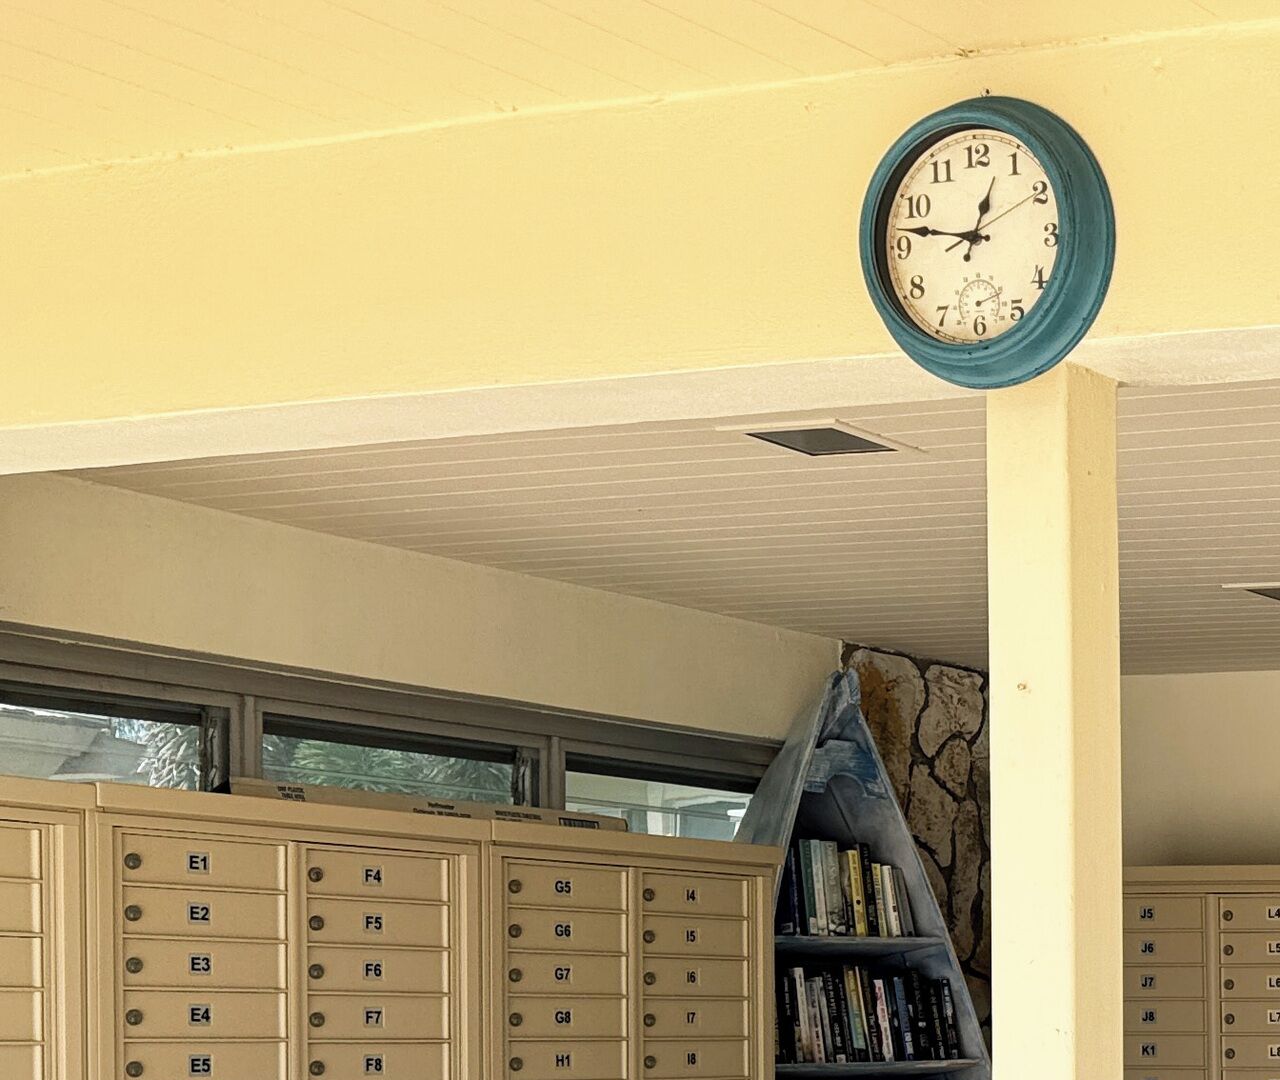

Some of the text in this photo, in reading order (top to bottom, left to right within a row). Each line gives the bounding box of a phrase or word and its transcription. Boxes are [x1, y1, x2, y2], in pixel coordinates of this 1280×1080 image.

[964, 144, 990, 169] 12
[1008, 152, 1021, 176] 1
[930, 160, 955, 184] 11
[1032, 181, 1048, 204] 2
[904, 194, 930, 219] 10
[1044, 222, 1058, 247] 3
[897, 235, 911, 260] 9
[1031, 265, 1048, 290] 4
[910, 275, 925, 299] 8
[937, 305, 949, 327] 7
[1010, 299, 1024, 321] 5
[974, 315, 986, 336] 6
[189, 855, 207, 871] E1
[365, 868, 382, 883] F4
[554, 880, 572, 894] G5
[686, 889, 696, 902] I4
[189, 905, 210, 921] E2
[1140, 908, 1154, 919] J5
[1268, 908, 1280, 919] L4
[365, 915, 383, 931] F5
[554, 924, 571, 938] G6
[686, 930, 696, 943] I5
[1141, 942, 1154, 953] J6
[190, 956, 211, 972] E3
[365, 963, 382, 977] F6
[554, 967, 571, 981] G7
[686, 971, 696, 984] I6
[1141, 976, 1155, 988] J7
[190, 1007, 211, 1023] E4
[365, 1010, 382, 1025] F7
[554, 1010, 571, 1024] G8
[686, 1011, 696, 1024] I7
[1141, 1011, 1155, 1022] J8
[1141, 1045, 1155, 1056] K1
[190, 1057, 211, 1073] E5
[365, 1057, 383, 1072] F8
[555, 1054, 570, 1067] H1
[687, 1052, 697, 1065] I8
